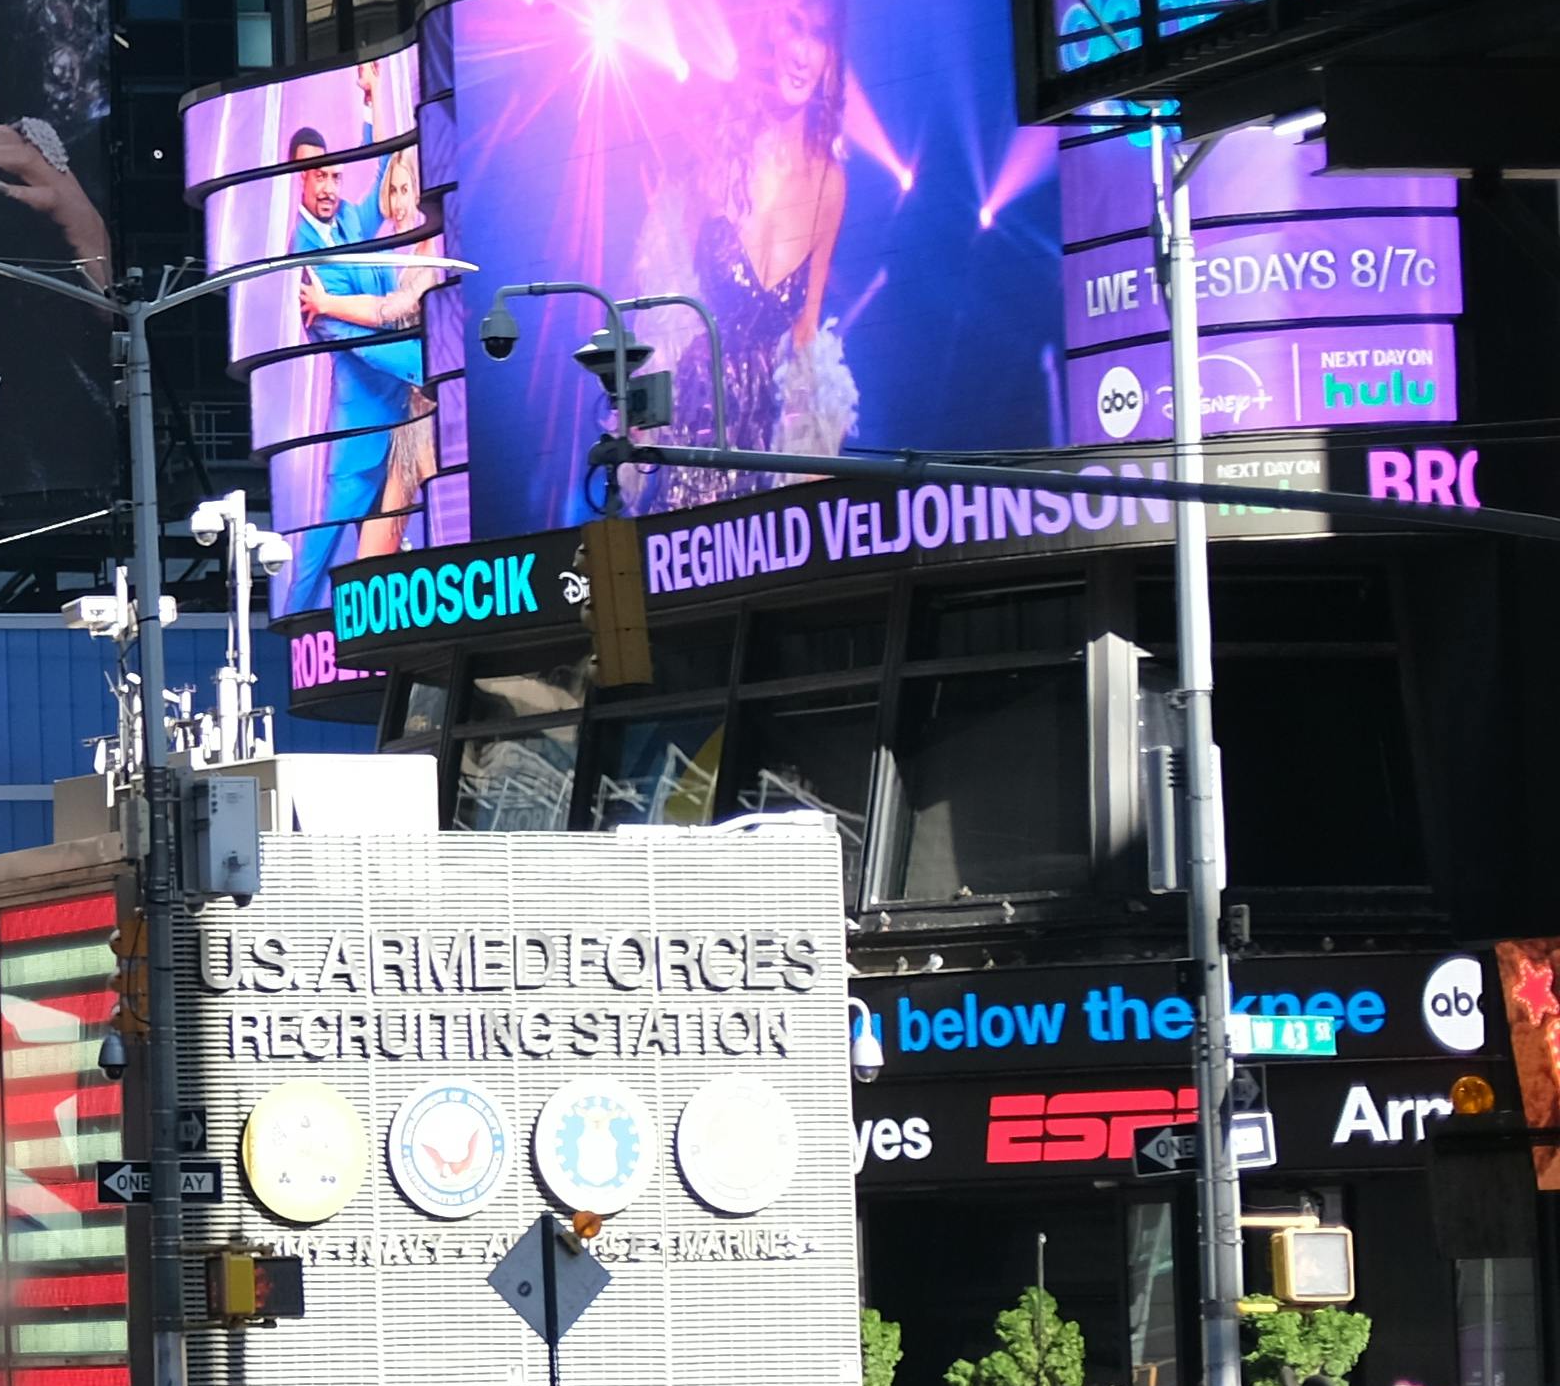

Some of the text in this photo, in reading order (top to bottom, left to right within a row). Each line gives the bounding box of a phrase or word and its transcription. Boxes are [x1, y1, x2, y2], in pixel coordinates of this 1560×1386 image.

[1086, 268, 1139, 318] LIVE
[1350, 245, 1437, 293] 8/7c
[1321, 349, 1434, 369] NEXT DAY ON
[1100, 387, 1139, 414] abc
[1323, 370, 1436, 409] hulu
[1216, 461, 1321, 480] NEXT DAY ON
[647, 506, 812, 594] REGINALD
[200, 927, 824, 995] U.S. ARMED FORCES
[227, 1008, 559, 1061] RECRUITING
[570, 1007, 793, 1057] STATION
[898, 993, 1067, 1052] below
[1082, 985, 1196, 1043] the
[116, 1174, 207, 1191] ONE AY
